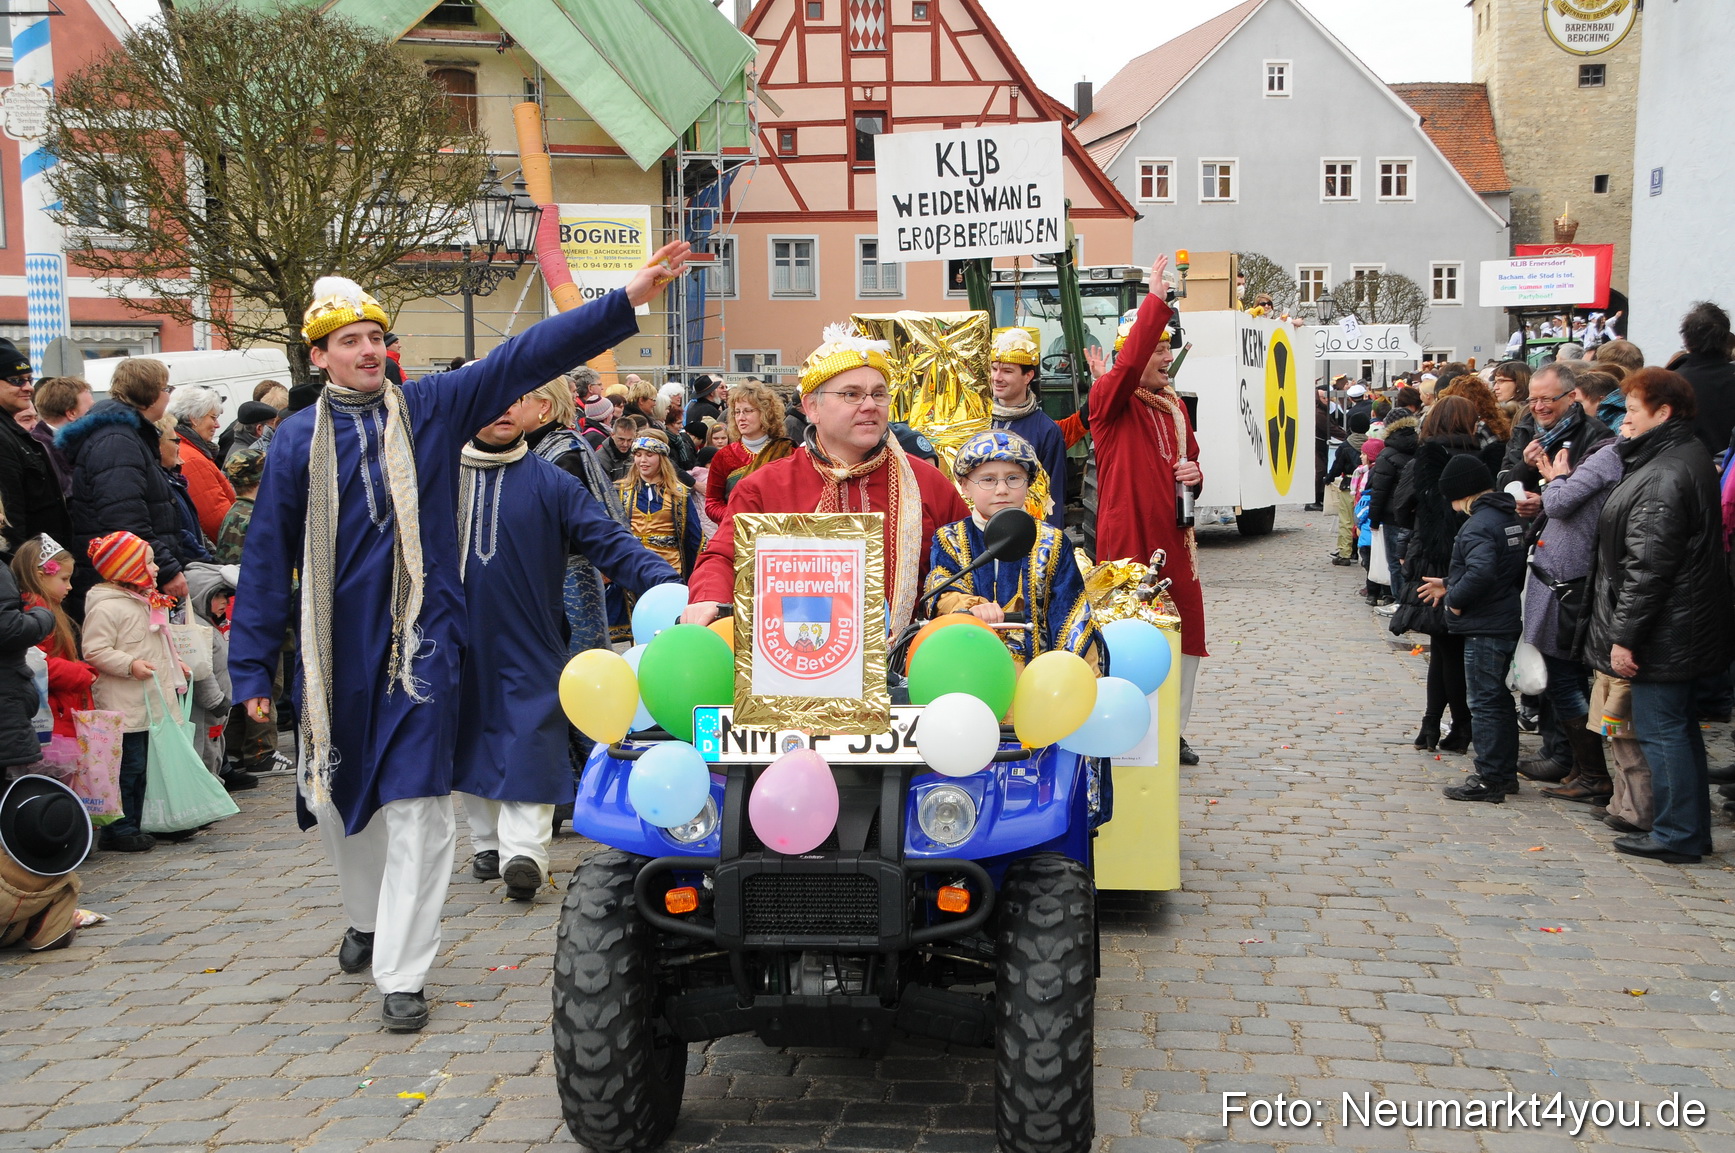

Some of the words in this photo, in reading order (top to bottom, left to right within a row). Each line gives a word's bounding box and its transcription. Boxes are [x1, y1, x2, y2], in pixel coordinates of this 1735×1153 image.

[1593, 1, 1620, 19] BERCHING
[1565, 22, 1614, 32] BÄRENBRÄU
[1567, 33, 1610, 43] BERCHING
[935, 138, 1000, 188] KLJB
[892, 183, 1042, 218] WEIDENWANG
[559, 224, 640, 244] BOGNER
[897, 217, 1058, 255] GROßBERGHAUSEN
[1344, 321, 1356, 333] 23
[1241, 328, 1266, 368] KERN-
[1239, 378, 1264, 466] GESUND
[766, 557, 852, 577] Freiwillige
[766, 576, 851, 593] Feuerwehr
[765, 617, 793, 666] Stadt
[795, 617, 853, 671] Berching
[703, 739, 712, 752] D
